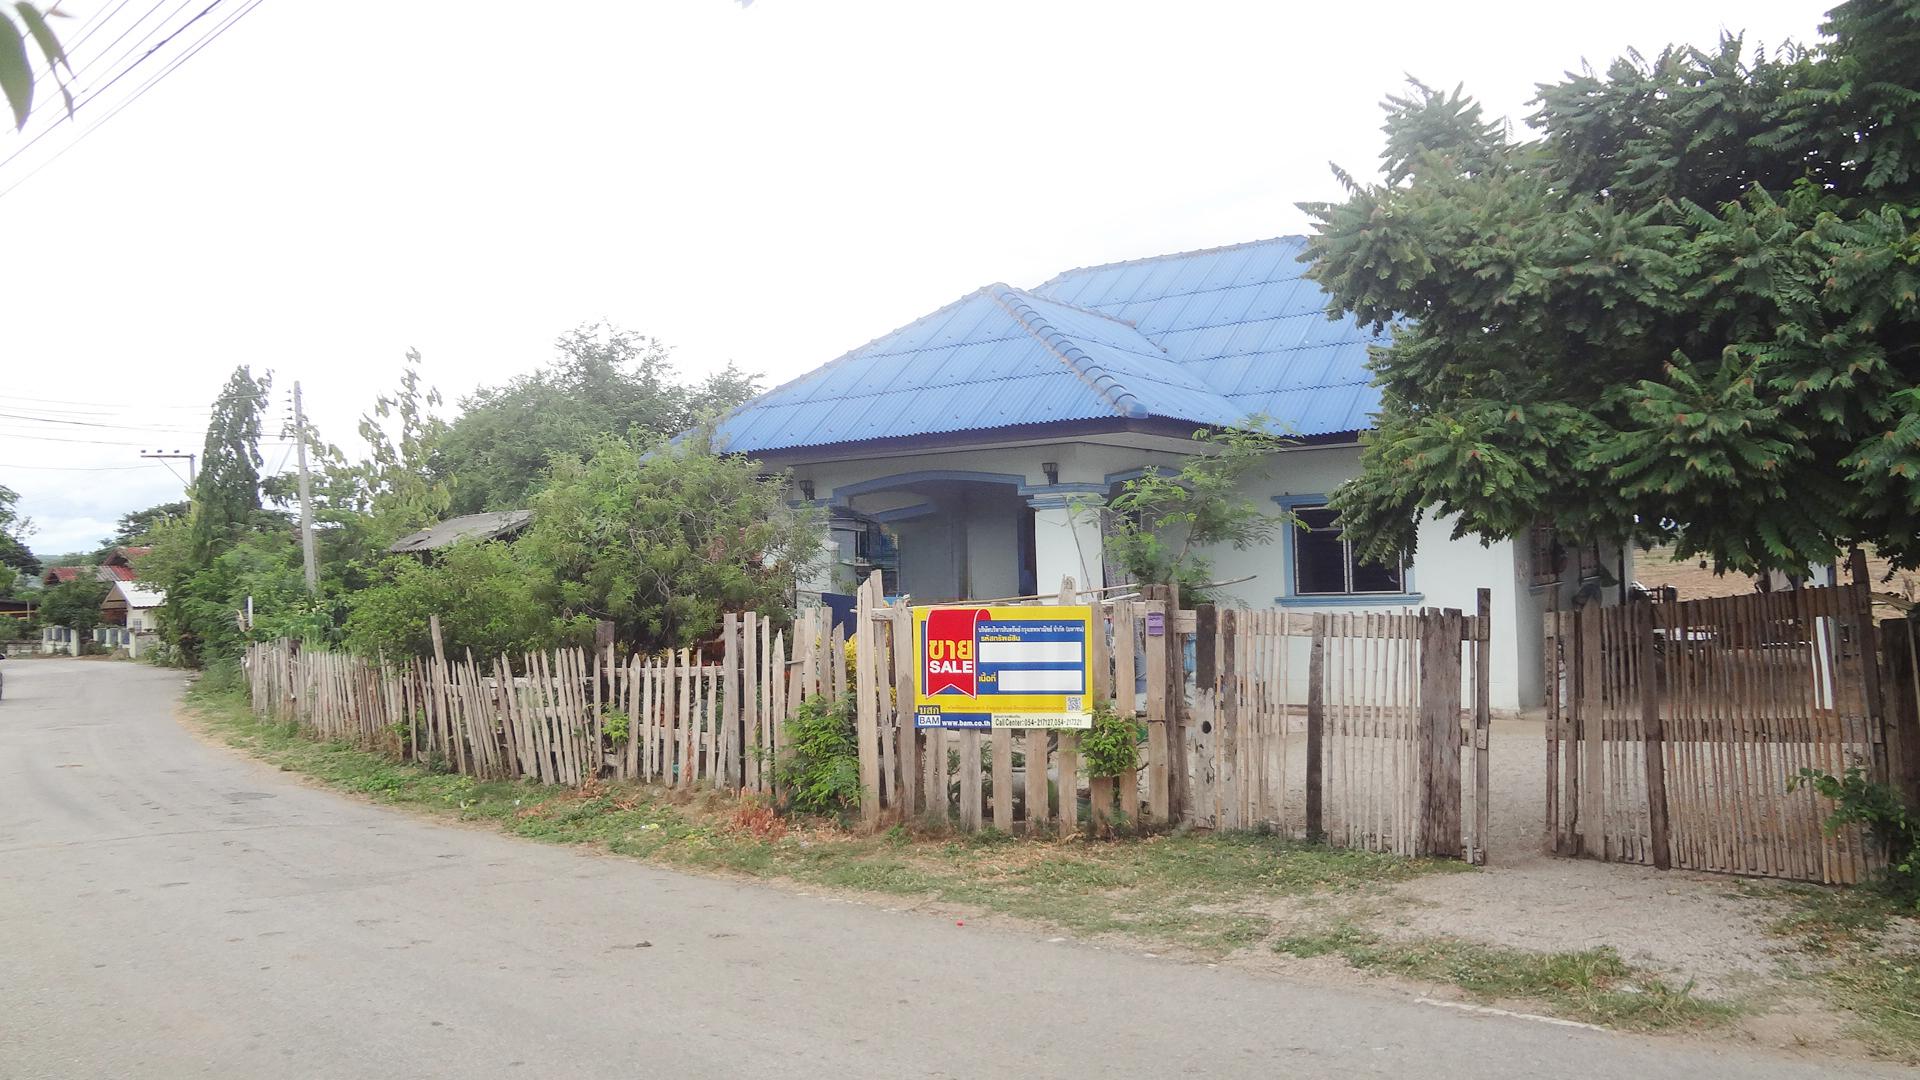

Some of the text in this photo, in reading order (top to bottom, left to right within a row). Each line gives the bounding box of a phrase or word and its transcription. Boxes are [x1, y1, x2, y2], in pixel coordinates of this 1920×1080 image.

[929, 639, 973, 660] ขาย
[929, 660, 974, 674] SALE
[919, 716, 940, 725] BAM
[942, 719, 991, 727] www.bam.co.th
[995, 718, 1005, 727] Call
